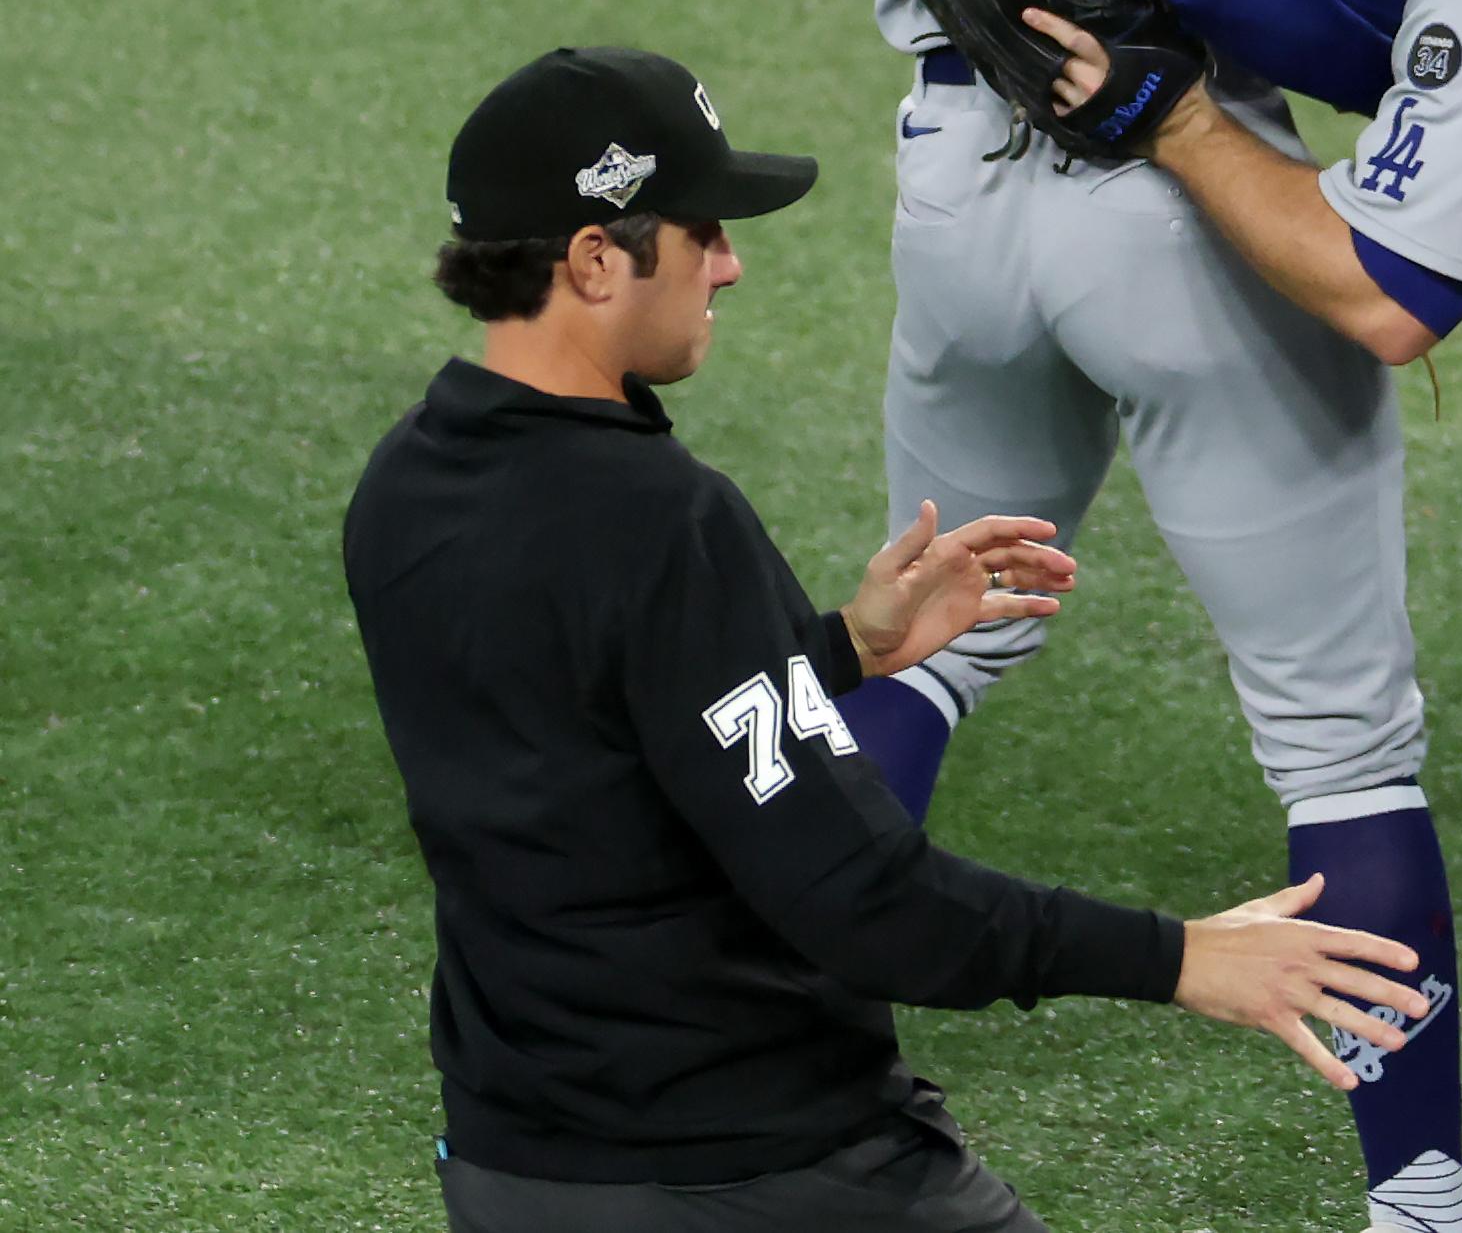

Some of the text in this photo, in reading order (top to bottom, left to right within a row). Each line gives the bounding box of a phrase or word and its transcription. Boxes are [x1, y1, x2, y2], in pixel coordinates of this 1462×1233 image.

[1413, 45, 1450, 80] 34
[1360, 96, 1425, 203] LA
[702, 654, 859, 806] 74
